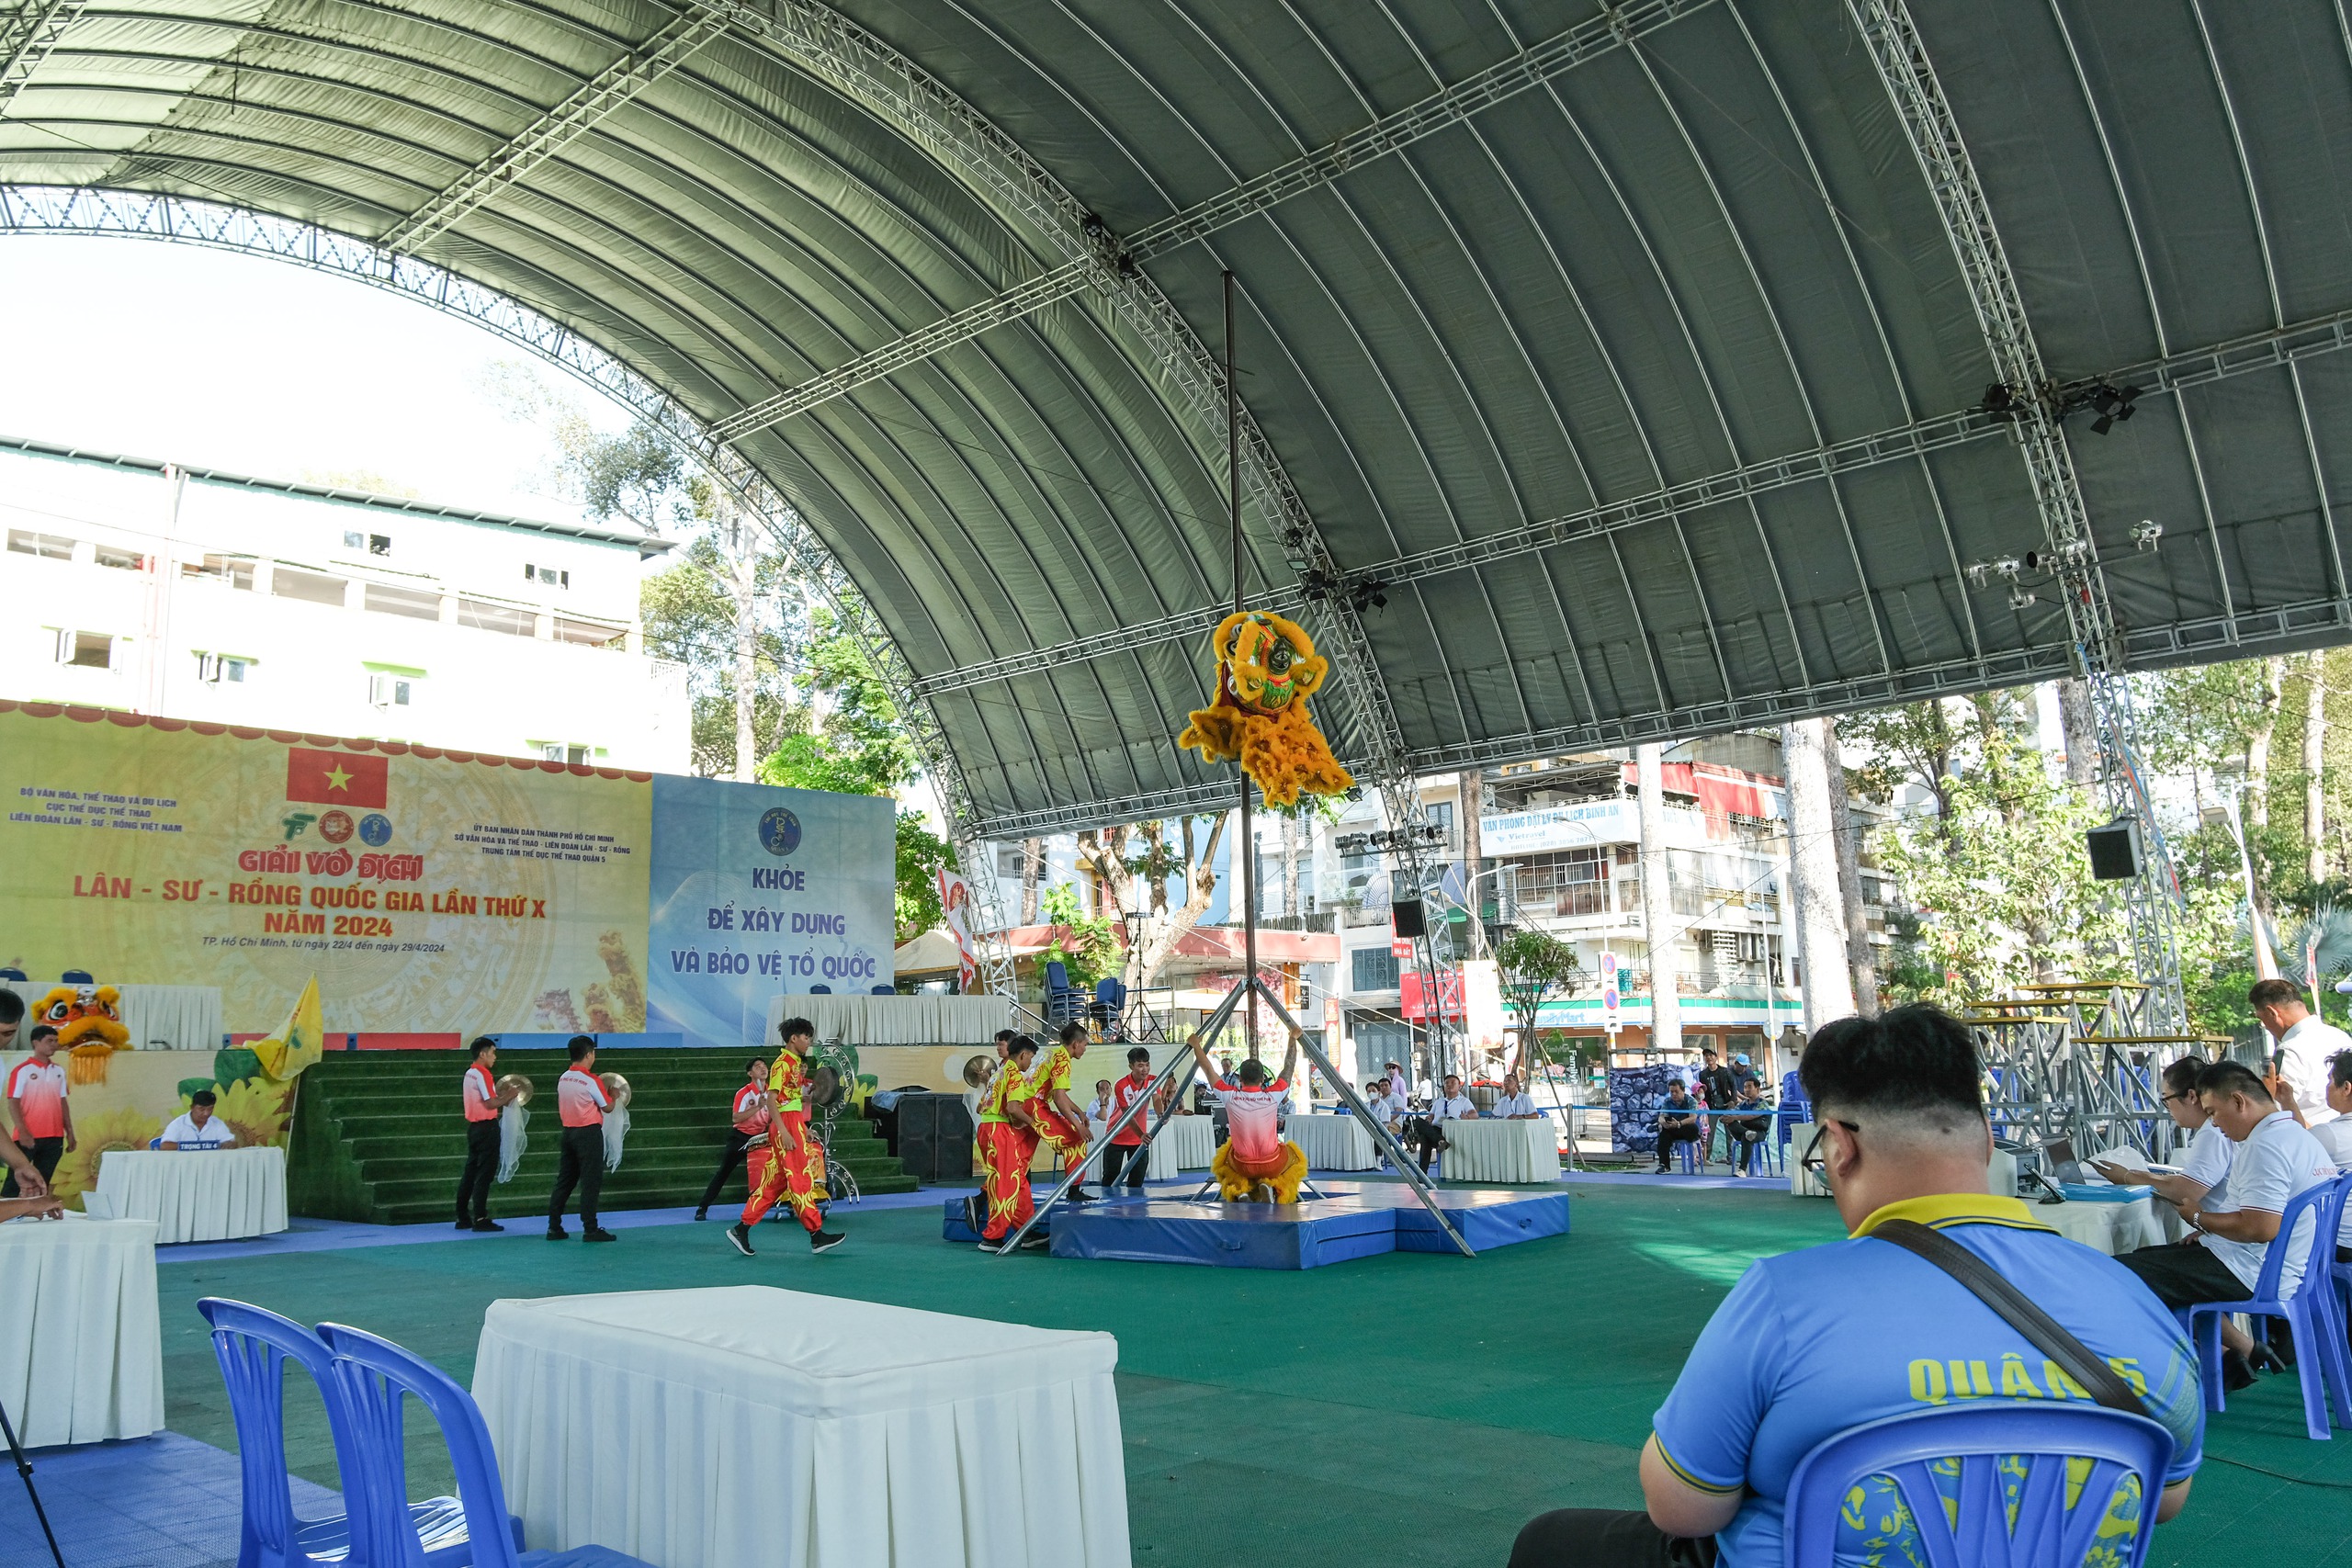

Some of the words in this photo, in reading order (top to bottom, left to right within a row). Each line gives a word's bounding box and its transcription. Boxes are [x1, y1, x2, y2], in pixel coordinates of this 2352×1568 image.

[103, 794, 125, 804] THAO
[129, 809, 151, 818] THAO
[1608, 804, 1619, 816] AN
[10, 812, 31, 821] LIÊN
[64, 815, 81, 825] LÂN
[161, 824, 182, 832] NAM
[500, 826, 519, 835] NHÂN
[1509, 830, 1545, 840] Vietravel
[522, 839, 538, 847] THAO
[482, 847, 504, 855] TRUNG
[506, 848, 520, 856] TÂM
[238, 844, 301, 873] GIẢI
[305, 847, 353, 877] VÔ
[357, 853, 423, 884] ĐỊCH
[752, 863, 805, 891] KHỎE
[74, 872, 131, 899] LÂN
[162, 879, 203, 901] SƯ
[229, 877, 301, 906] RỒNG
[310, 882, 377, 910] QUỐC
[385, 891, 424, 912] GIA
[432, 888, 476, 915] LẦN
[484, 894, 527, 917] THỨ
[532, 900, 545, 918] X
[264, 908, 325, 935] NĂM
[333, 915, 393, 937] 2024
[707, 900, 734, 930] ĐỂ
[741, 906, 785, 933] XÂY
[792, 912, 845, 939] DỰNG
[203, 937, 217, 946] TP.
[240, 937, 257, 946] Chí
[304, 940, 330, 950] ngày
[332, 940, 352, 949] 22/4
[355, 940, 372, 950] đến
[376, 942, 398, 952] ngày
[402, 943, 444, 952] 29/4/2024
[671, 947, 700, 974] VÀ
[707, 946, 749, 975] BẢO
[757, 950, 781, 980] VỆ
[789, 947, 815, 977] TỔ
[822, 950, 875, 980] QUỐC
[1535, 1012, 1584, 1023] amilyMart
[1908, 1352, 2092, 1405] QUẬN
[2108, 1357, 2148, 1397] 5
